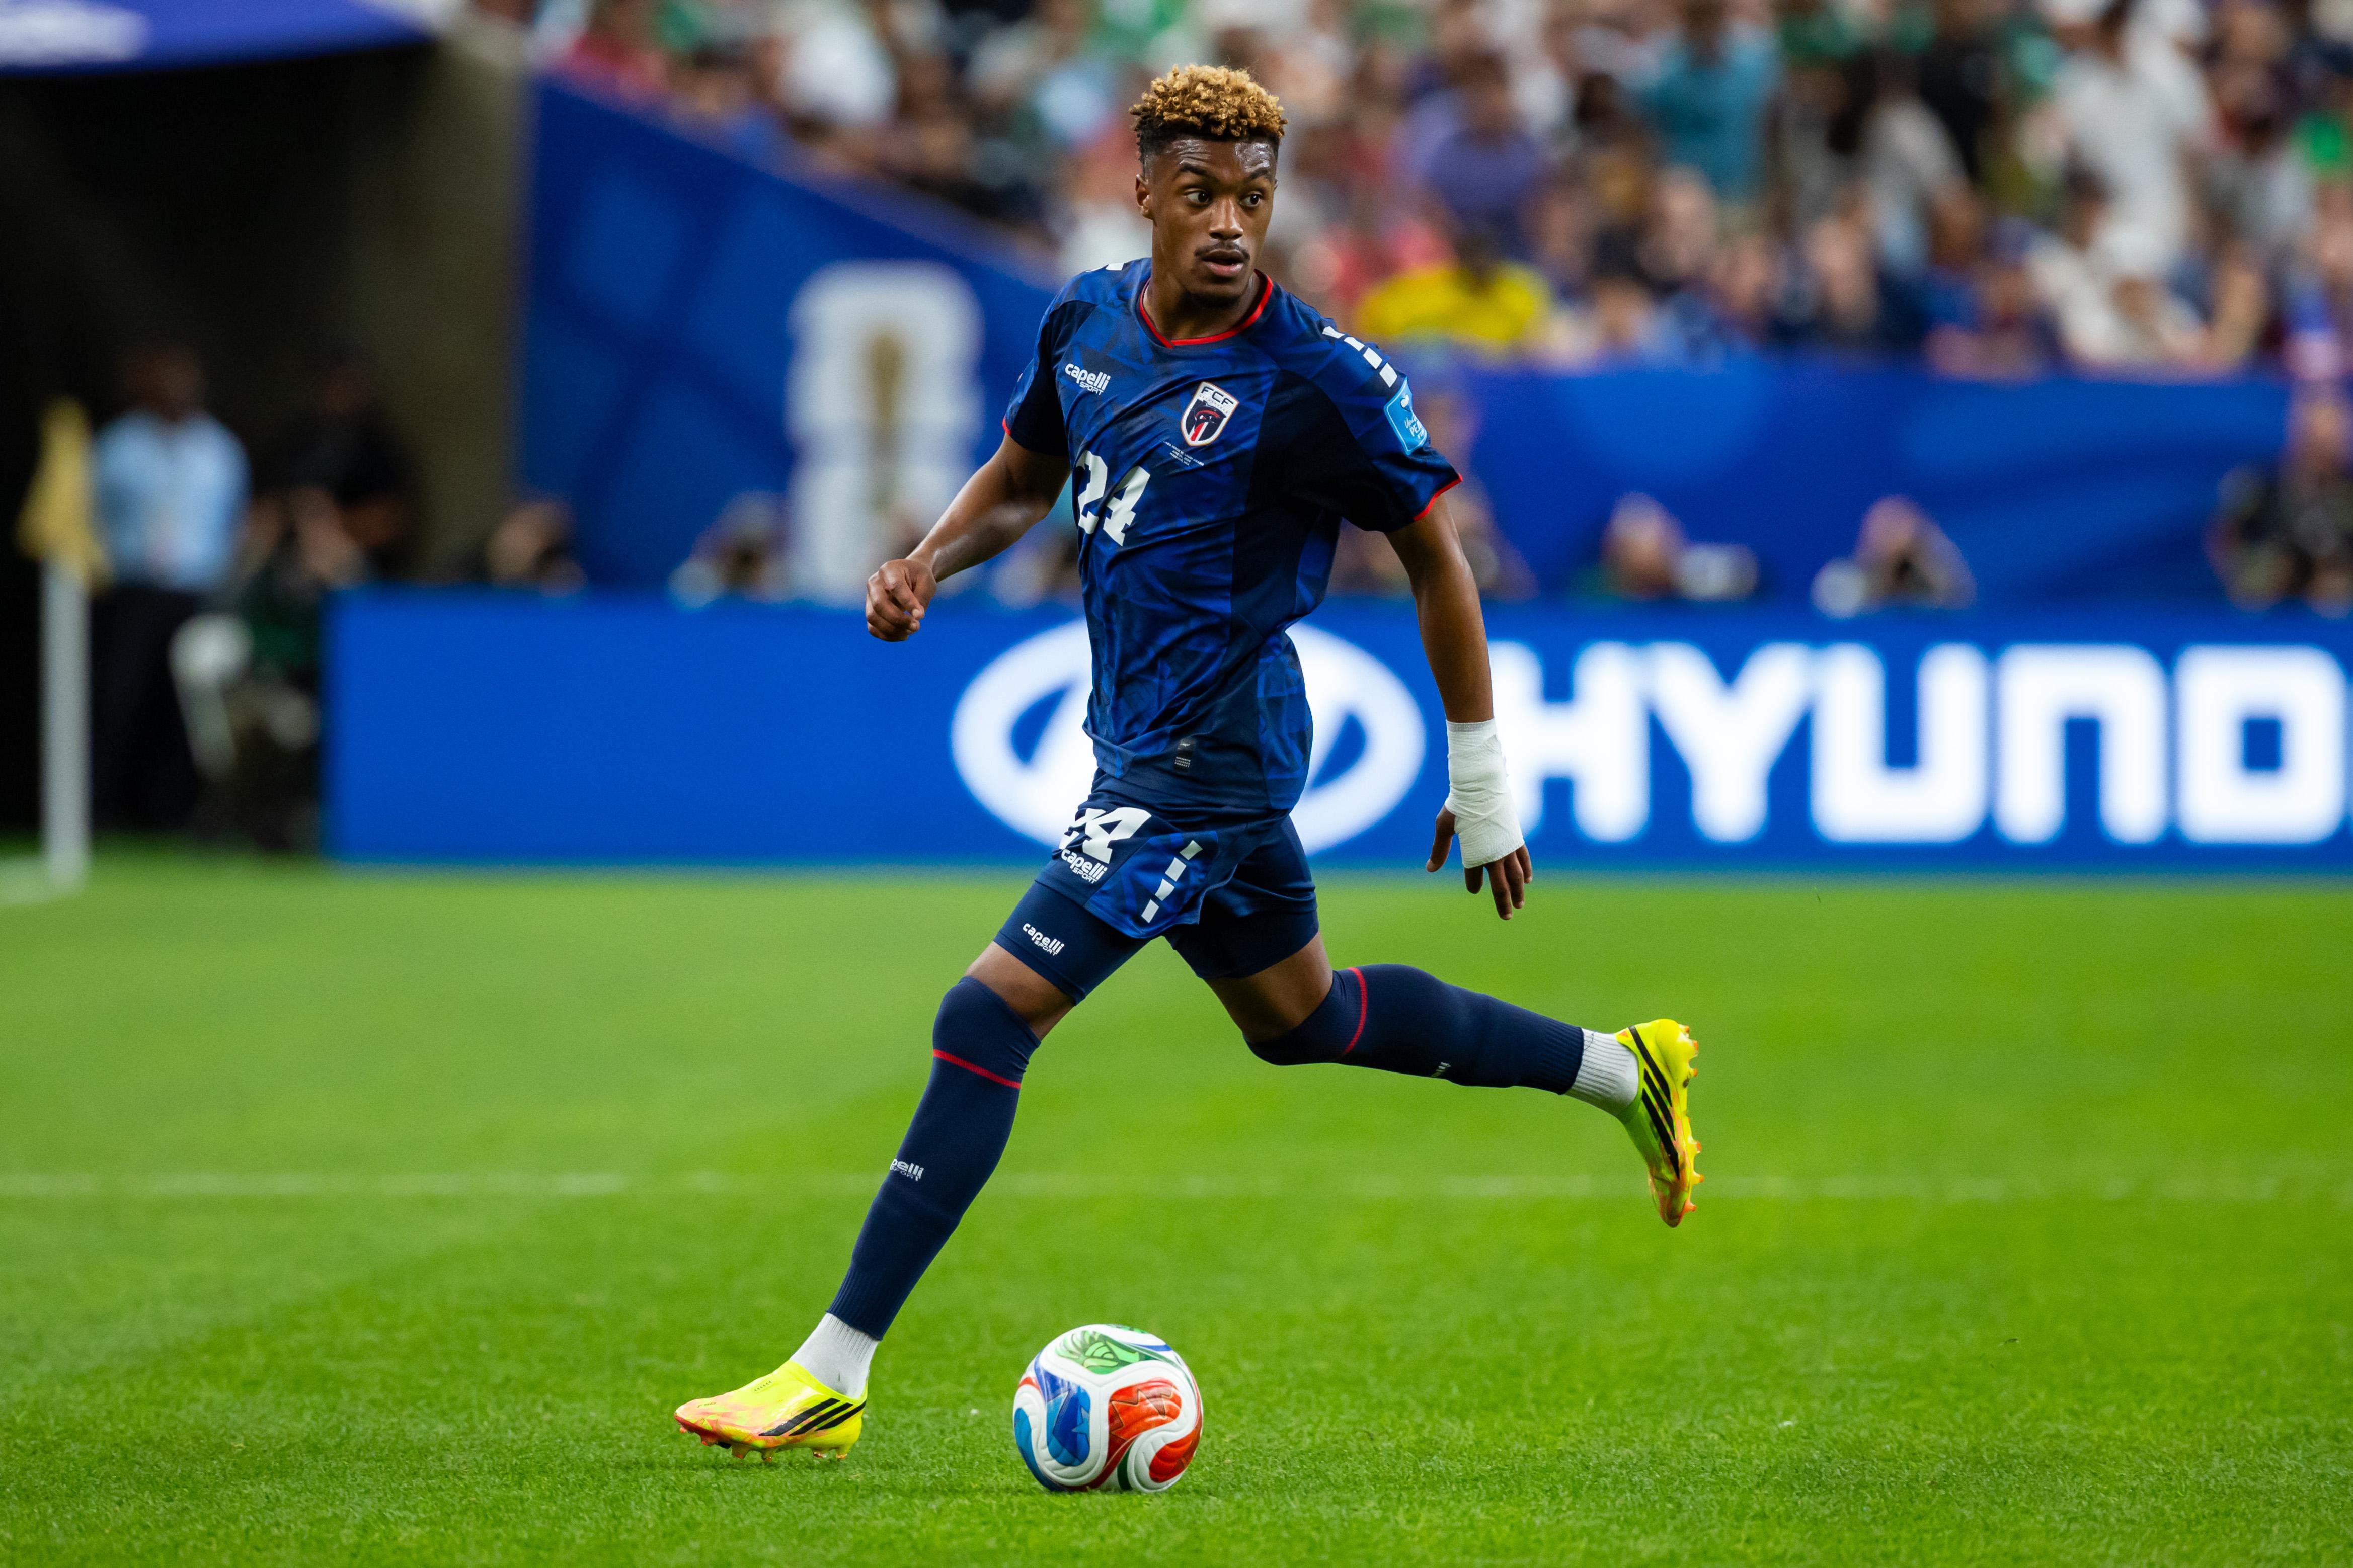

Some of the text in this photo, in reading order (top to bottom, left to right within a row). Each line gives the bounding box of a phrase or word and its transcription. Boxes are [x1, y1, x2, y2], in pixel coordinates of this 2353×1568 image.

[1065, 363, 1111, 391] capelli
[1079, 381, 1104, 395] SPORT
[1201, 386, 1234, 405] FCF
[1076, 450, 1151, 546] 24
[1485, 641, 2353, 844] HYUND
[1061, 849, 1108, 880] capelli
[1072, 868, 1097, 884] SPORT
[1023, 923, 1065, 954] capelli
[1034, 940, 1058, 956] SPORT
[890, 1158, 924, 1176] pelli
